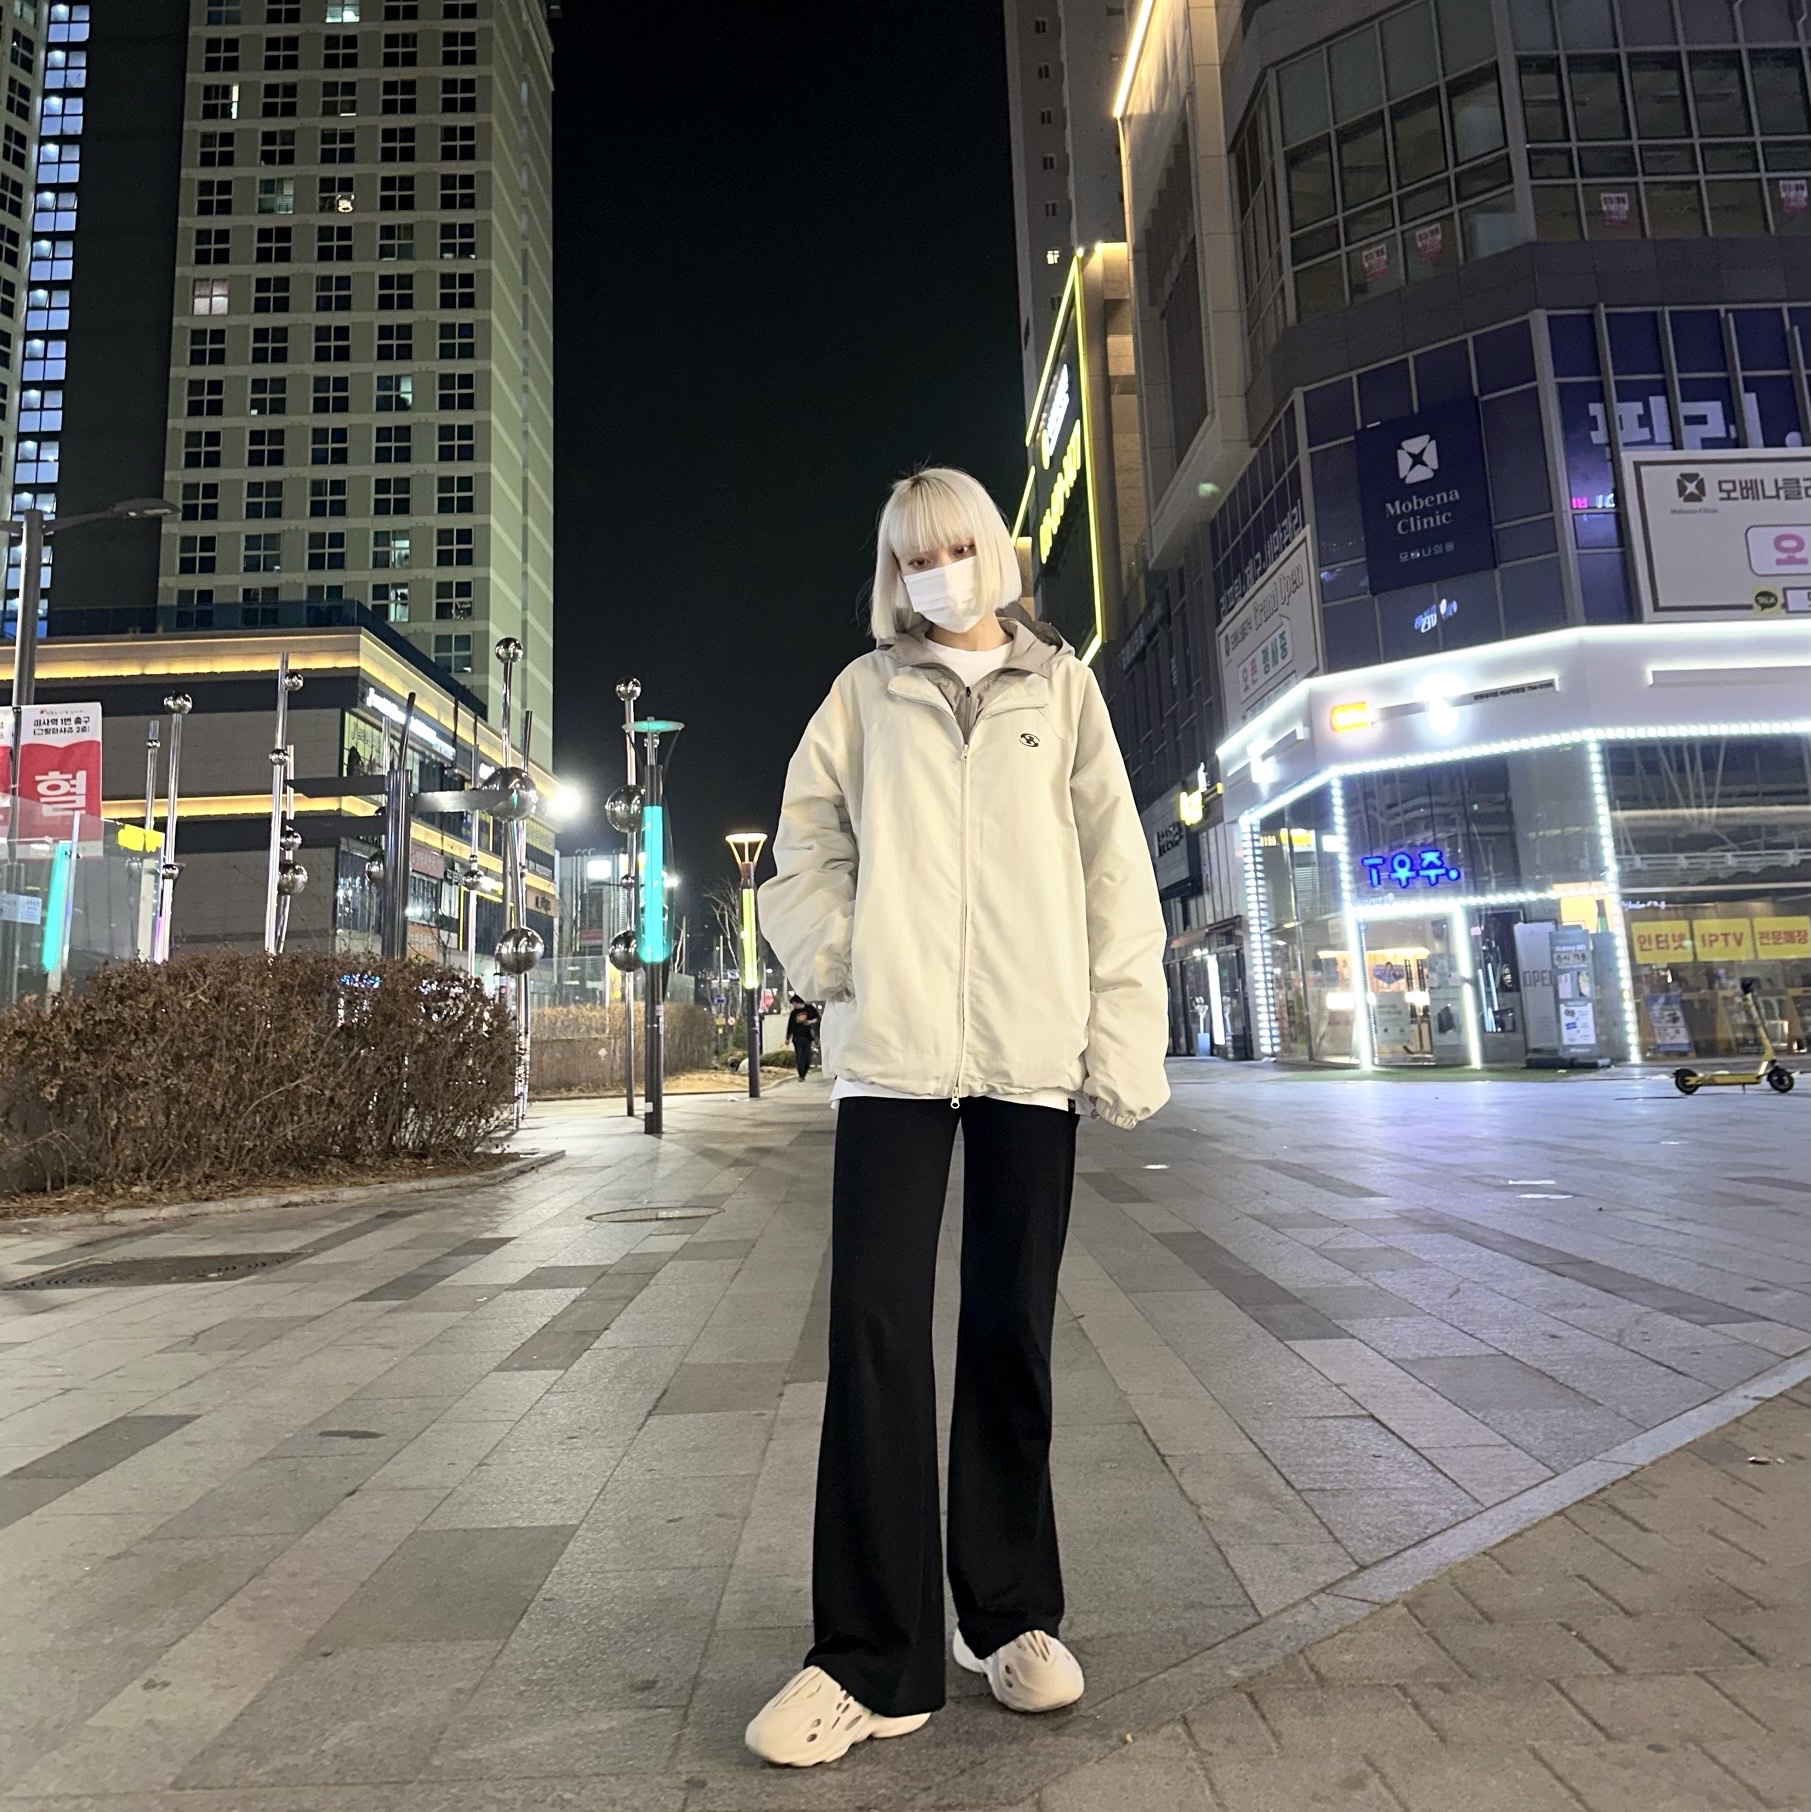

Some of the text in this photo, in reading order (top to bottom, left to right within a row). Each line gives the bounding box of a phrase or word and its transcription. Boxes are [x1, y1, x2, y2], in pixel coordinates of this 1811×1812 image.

[1385, 489, 1460, 519] Mobena
[1397, 511, 1453, 535] Clinic
[1252, 564, 1304, 632] Grand Open
[1637, 933, 1687, 951] 인터넷
[1701, 932, 1744, 948] IPTV
[1523, 970, 1552, 987] OPE
